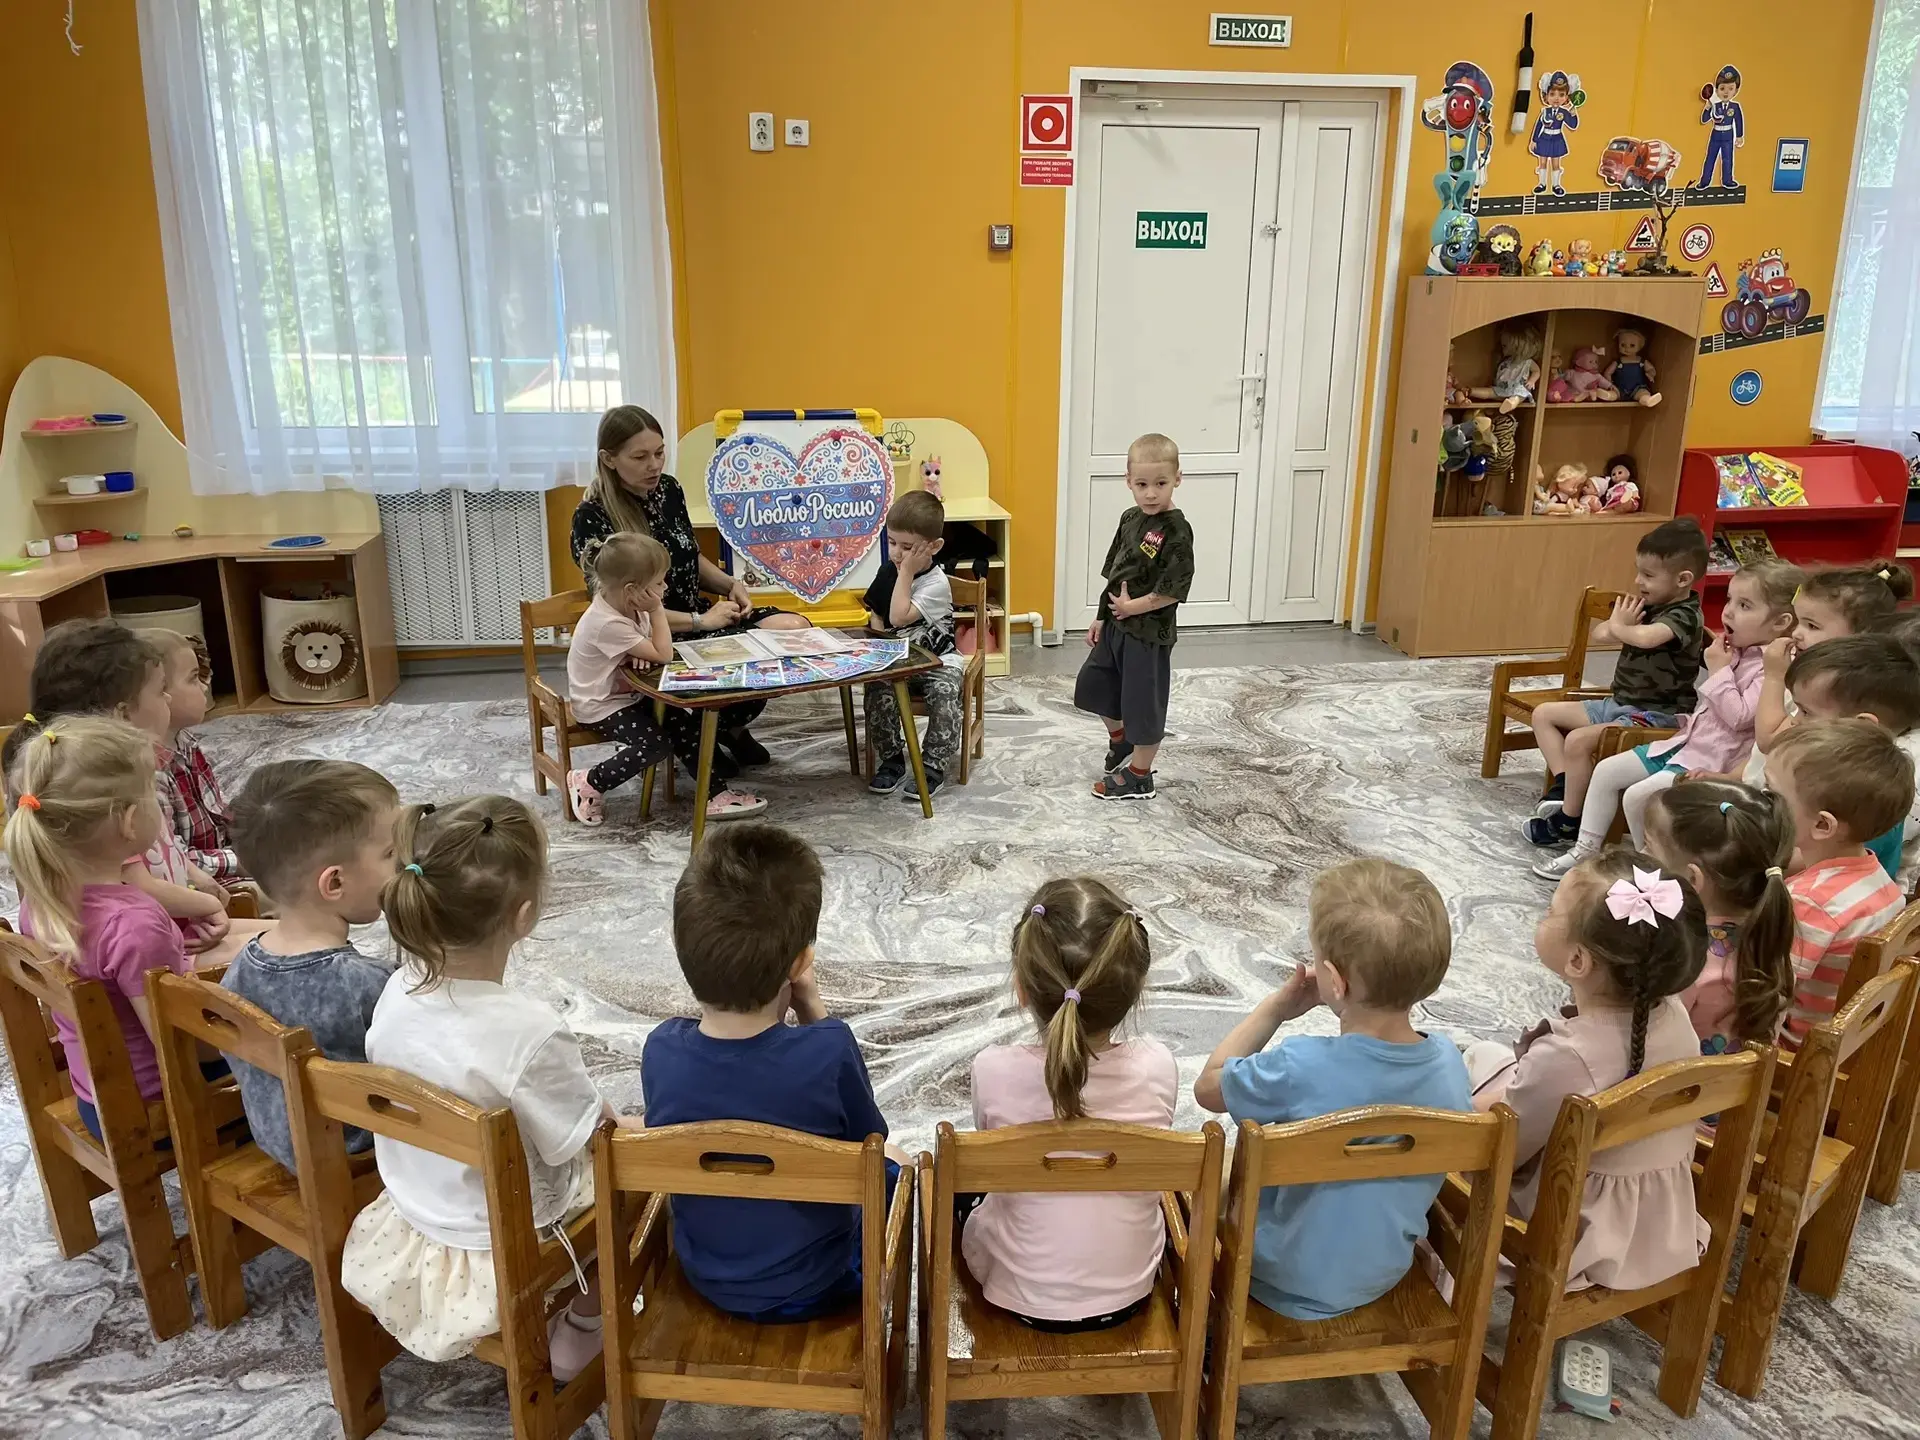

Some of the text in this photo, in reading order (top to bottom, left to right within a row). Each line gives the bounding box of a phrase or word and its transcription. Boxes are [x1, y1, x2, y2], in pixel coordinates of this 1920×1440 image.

[1219, 22, 1282, 40] ВЫХОД
[1138, 220, 1204, 244] ВЫХОД
[733, 491, 876, 529] Люблю Россию
